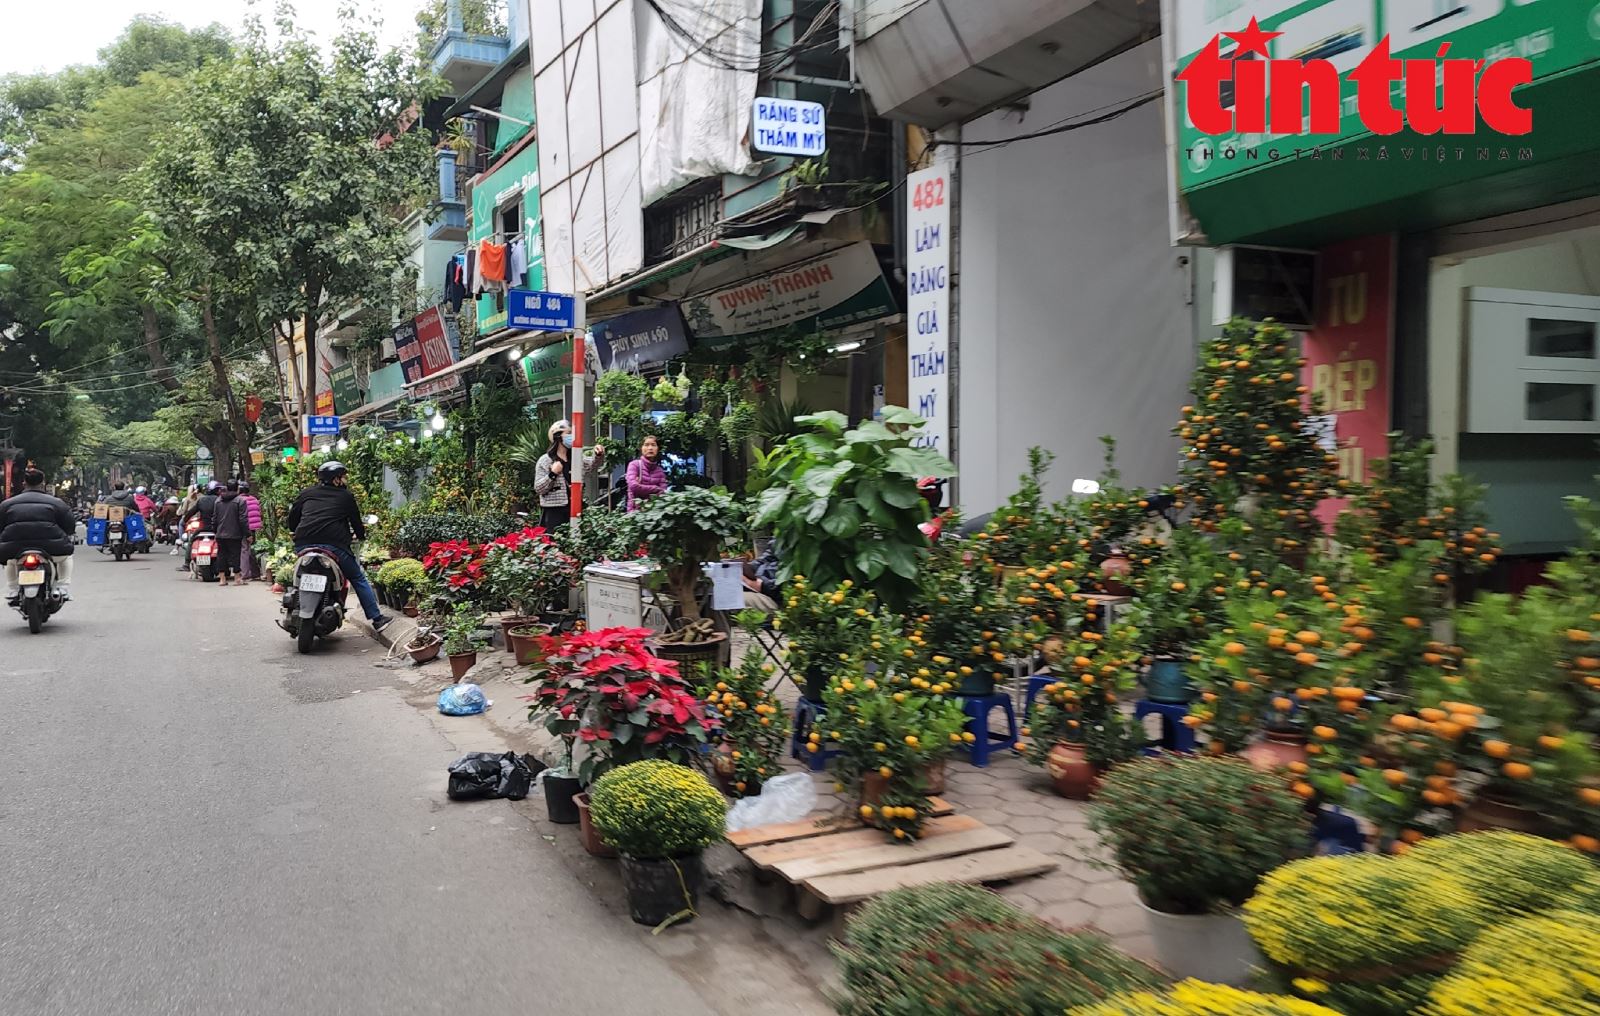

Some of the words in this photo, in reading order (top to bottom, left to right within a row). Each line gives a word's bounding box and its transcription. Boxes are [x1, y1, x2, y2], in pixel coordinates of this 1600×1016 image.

[912, 176, 945, 212] 482
[915, 222, 942, 253] LÀM
[546, 297, 562, 311] 484
[916, 301, 939, 336] GIẢ
[910, 341, 945, 378] THẨM
